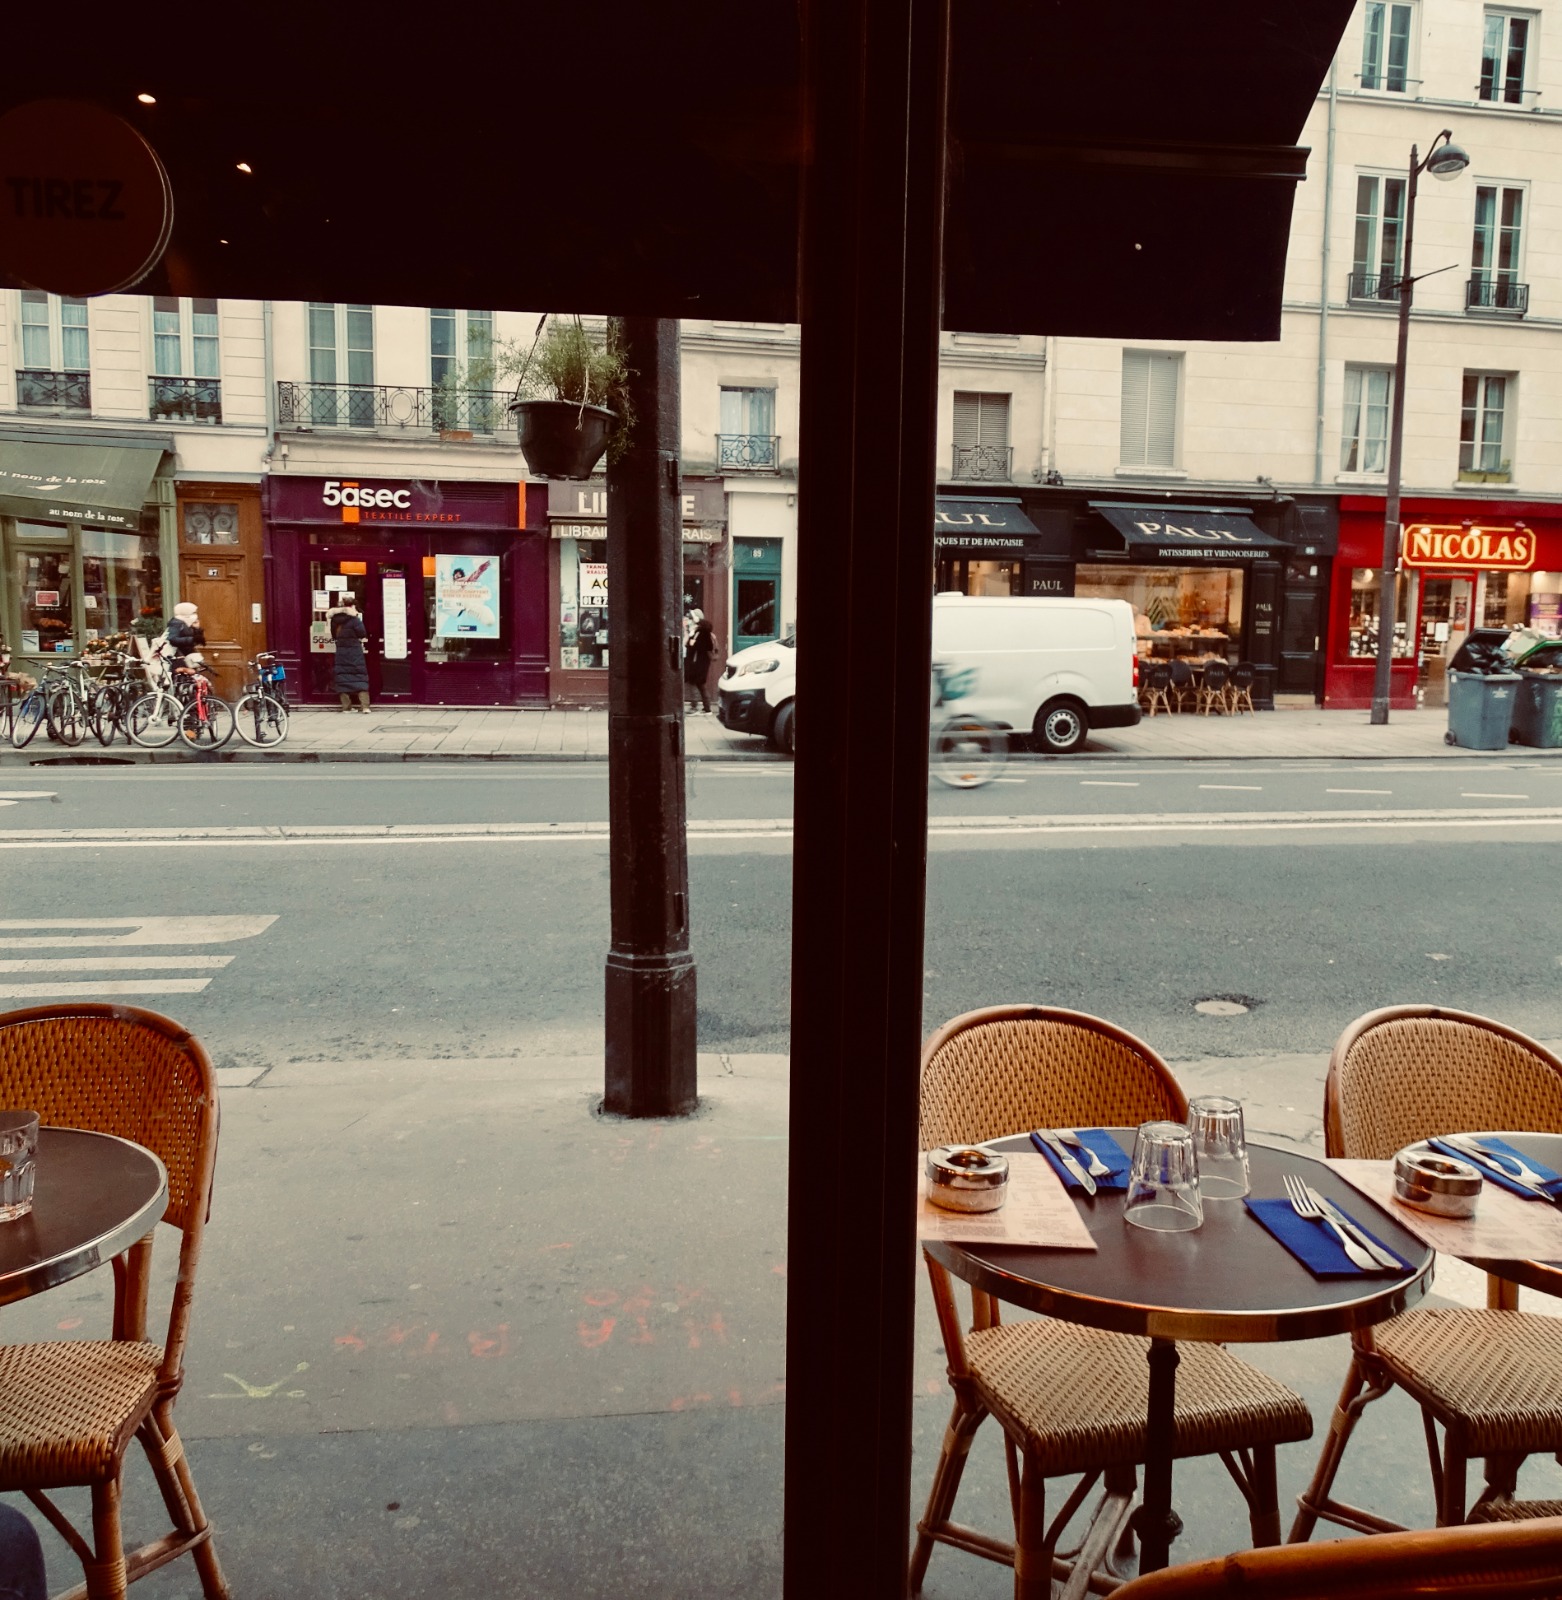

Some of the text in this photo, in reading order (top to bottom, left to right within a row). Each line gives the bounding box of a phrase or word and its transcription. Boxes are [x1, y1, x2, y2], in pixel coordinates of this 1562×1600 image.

[6, 177, 125, 220] TIREZ
[11, 472, 42, 481] nom
[46, 475, 62, 483] de
[65, 476, 77, 484] la
[49, 508, 124, 522] au nom de la rose
[364, 511, 461, 522] TEXTILE EXPERT
[935, 511, 1006, 526] UL
[681, 528, 712, 540] RAIS
[1134, 521, 1253, 542] PAUL
[935, 537, 1024, 547] QUES ET DE FANTAISIE
[1412, 533, 1527, 561] NICOLAS
[1158, 549, 1202, 557] PATISSERIES
[1214, 550, 1269, 558] VIENNOISERIES
[1033, 579, 1063, 590] PAUL
[313, 635, 337, 644] 5ase
